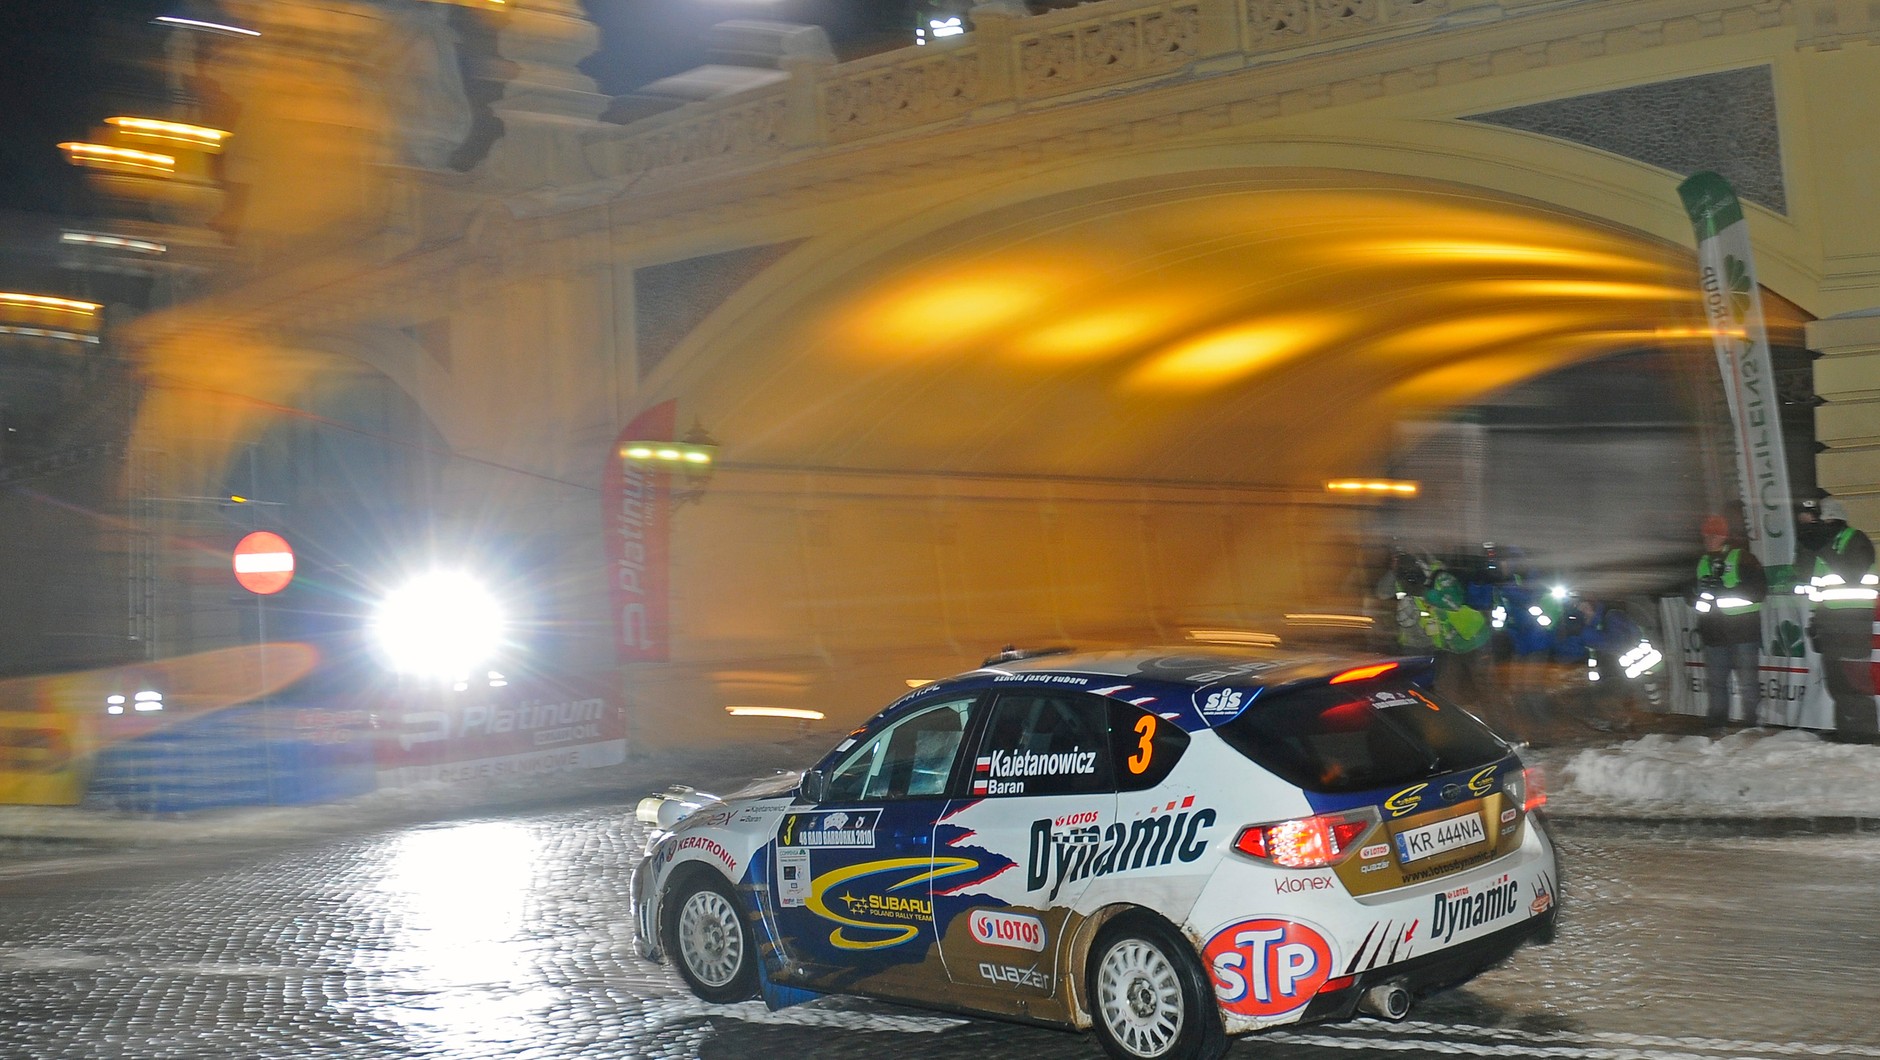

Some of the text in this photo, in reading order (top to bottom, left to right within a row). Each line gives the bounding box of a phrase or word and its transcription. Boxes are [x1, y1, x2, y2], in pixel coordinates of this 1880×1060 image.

[1051, 675, 1089, 686] subaru
[460, 698, 604, 738] Platinum
[1128, 714, 1157, 775] 3
[989, 745, 1096, 778] Kajetanowicz
[988, 779, 1024, 795] Baran
[783, 815, 797, 845] 3
[1066, 811, 1098, 825] LOTOS
[808, 831, 823, 845] RAJD
[855, 829, 872, 845] 2010
[1027, 798, 1217, 902] Dynamic
[1370, 845, 1387, 855] LOTOS
[1409, 831, 1435, 855] KR
[1437, 818, 1482, 846] 444NA
[677, 836, 737, 872] KERATRONIK
[1401, 847, 1498, 884] www.lotosdynamic.pl
[1274, 876, 1335, 895] klonex
[1453, 886, 1469, 898] LOTOS
[869, 895, 932, 914] SUBARU
[870, 909, 933, 922] POLAND RALLY TEAM
[1431, 876, 1518, 944] Dynamic
[995, 918, 1039, 944] LOTOS
[979, 961, 1050, 990] quazar
[1213, 927, 1318, 1003] STP
